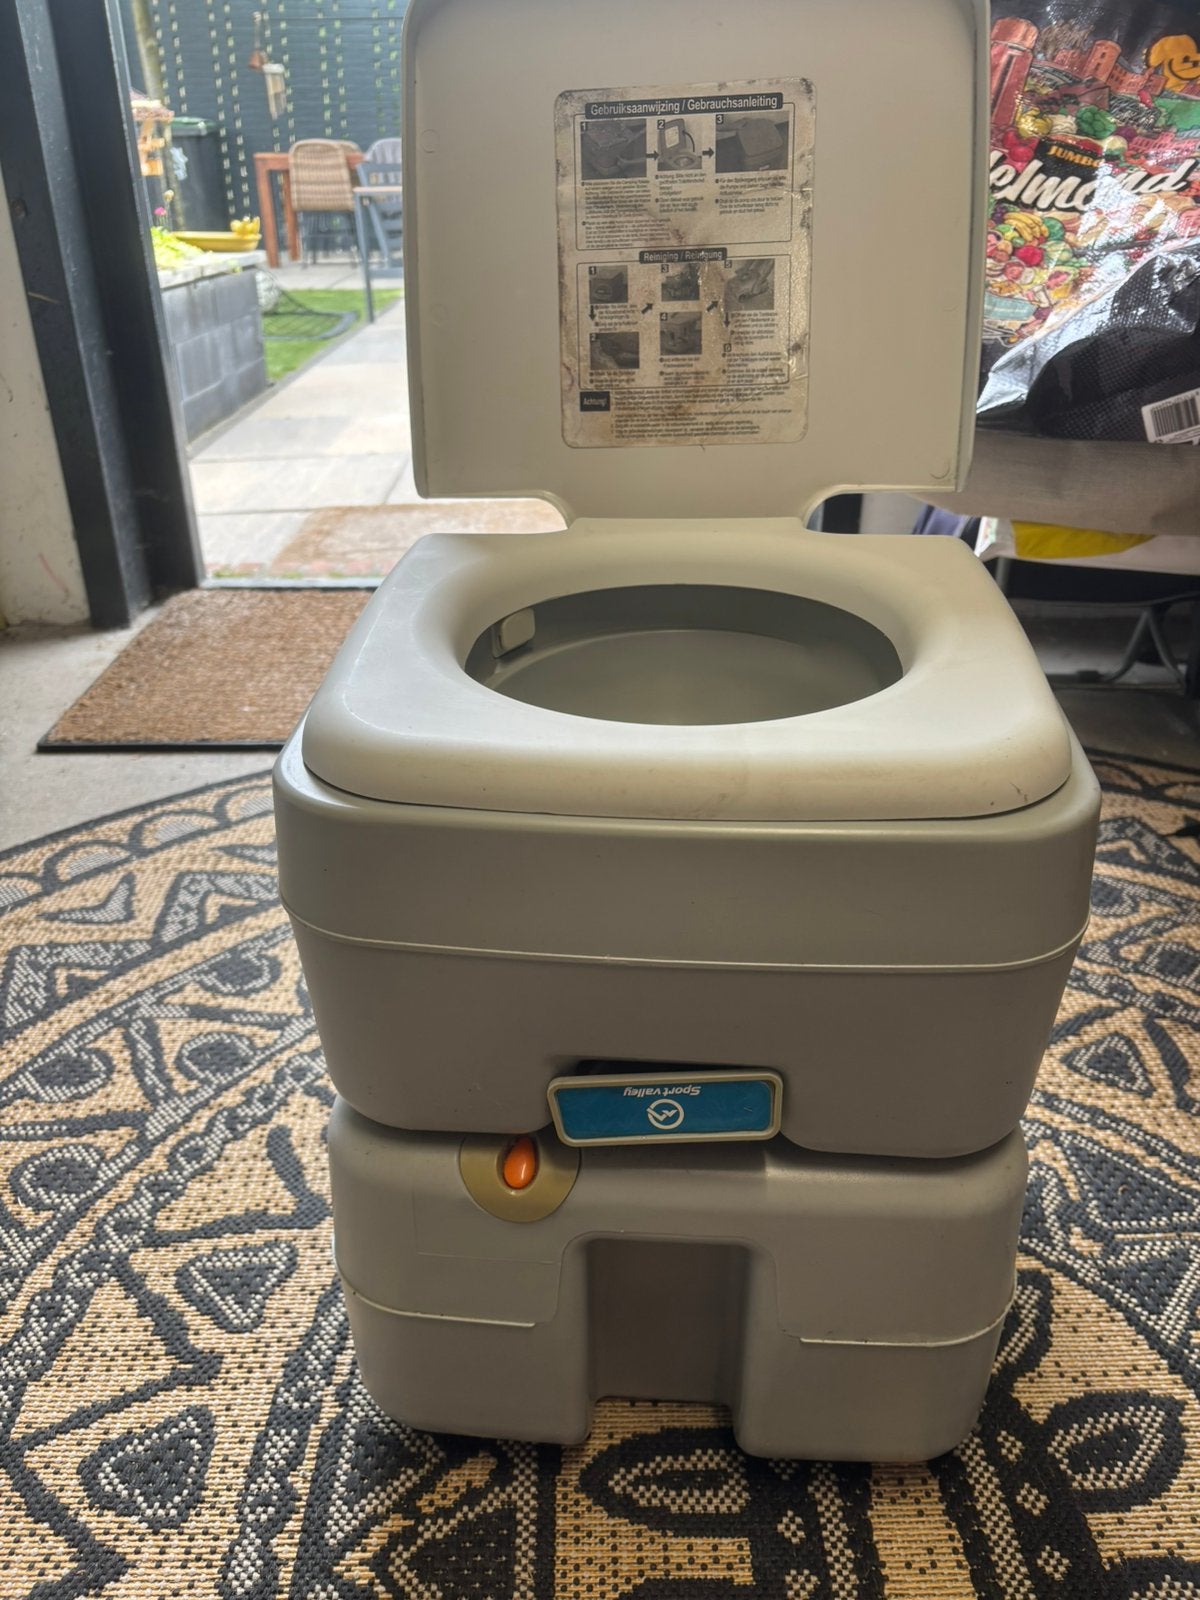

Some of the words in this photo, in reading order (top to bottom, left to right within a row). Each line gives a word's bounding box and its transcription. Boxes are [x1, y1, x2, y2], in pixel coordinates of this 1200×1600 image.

[591, 101, 680, 115] Gebruiksaanwijzing
[681, 99, 686, 111] /
[990, 150, 1196, 211] elmond
[643, 252, 679, 263] Reiniging
[623, 1086, 661, 1098] valley
[662, 1085, 701, 1097] Sport
